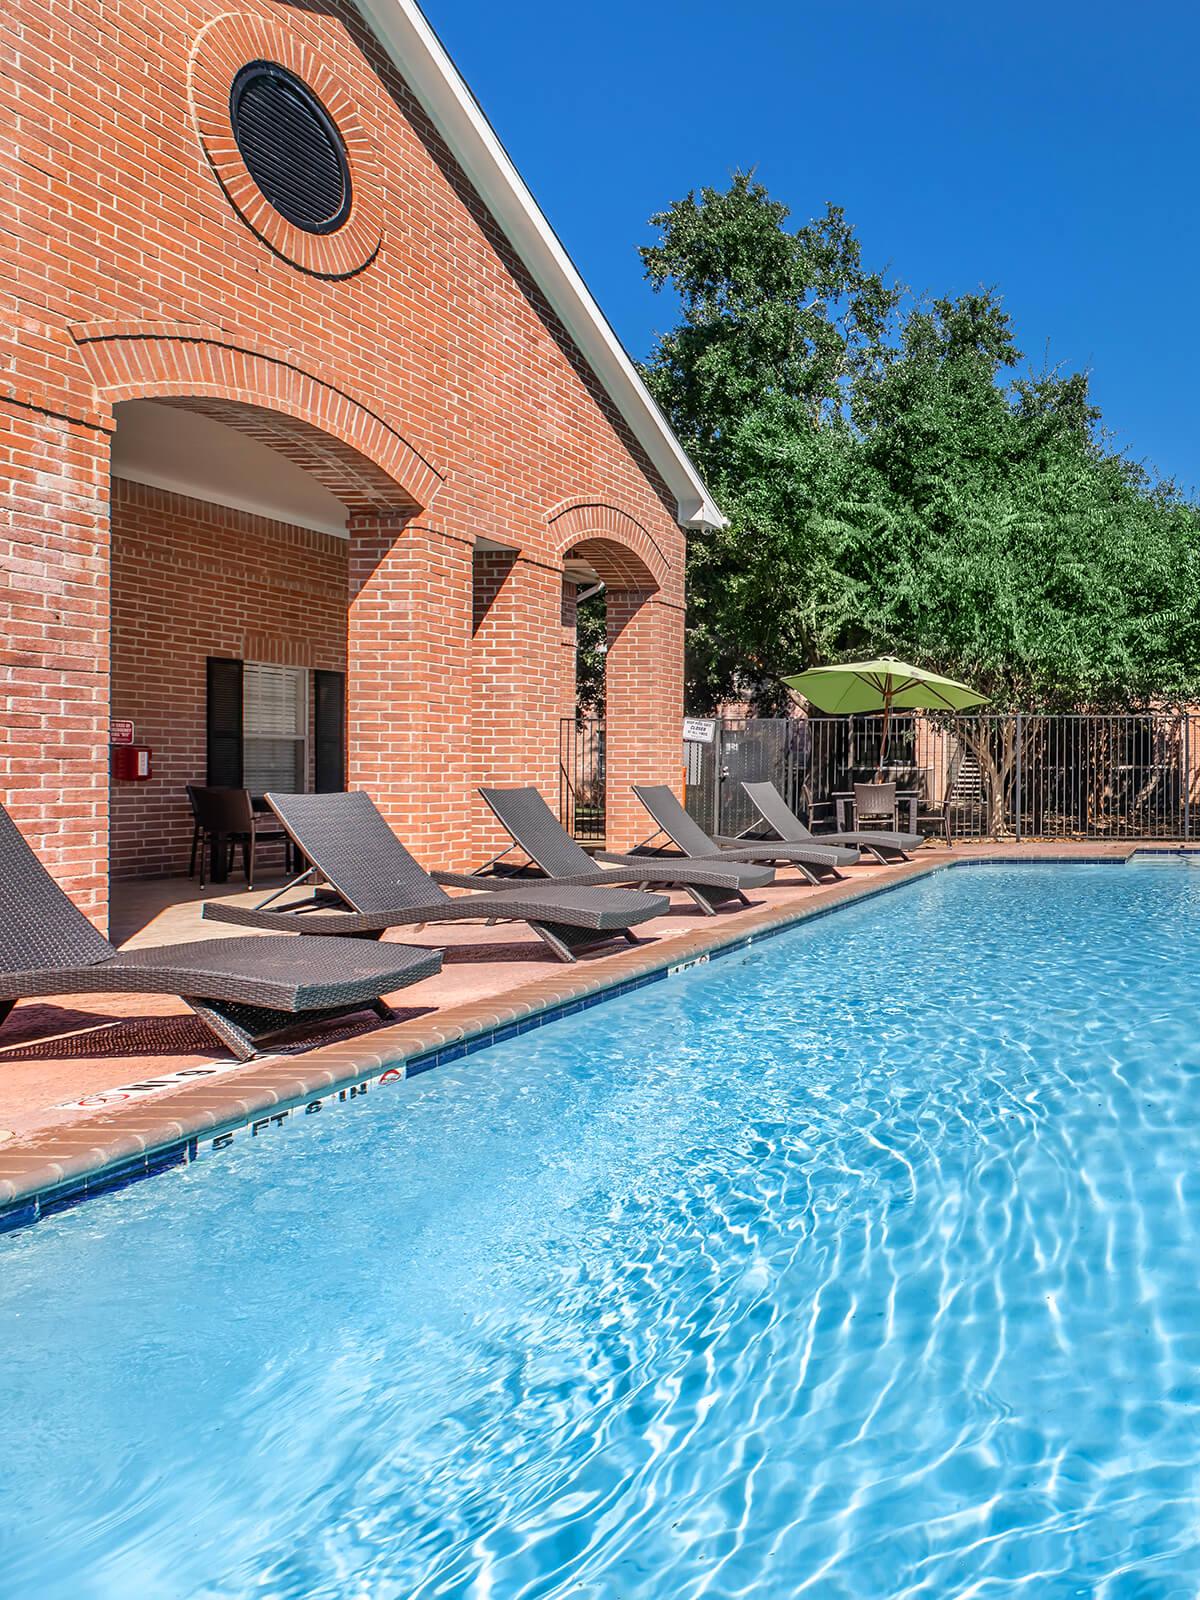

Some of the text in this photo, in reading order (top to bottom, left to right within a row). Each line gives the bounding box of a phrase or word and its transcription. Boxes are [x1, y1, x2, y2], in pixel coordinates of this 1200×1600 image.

[212, 1082, 369, 1150] 5 FT 6 IN
